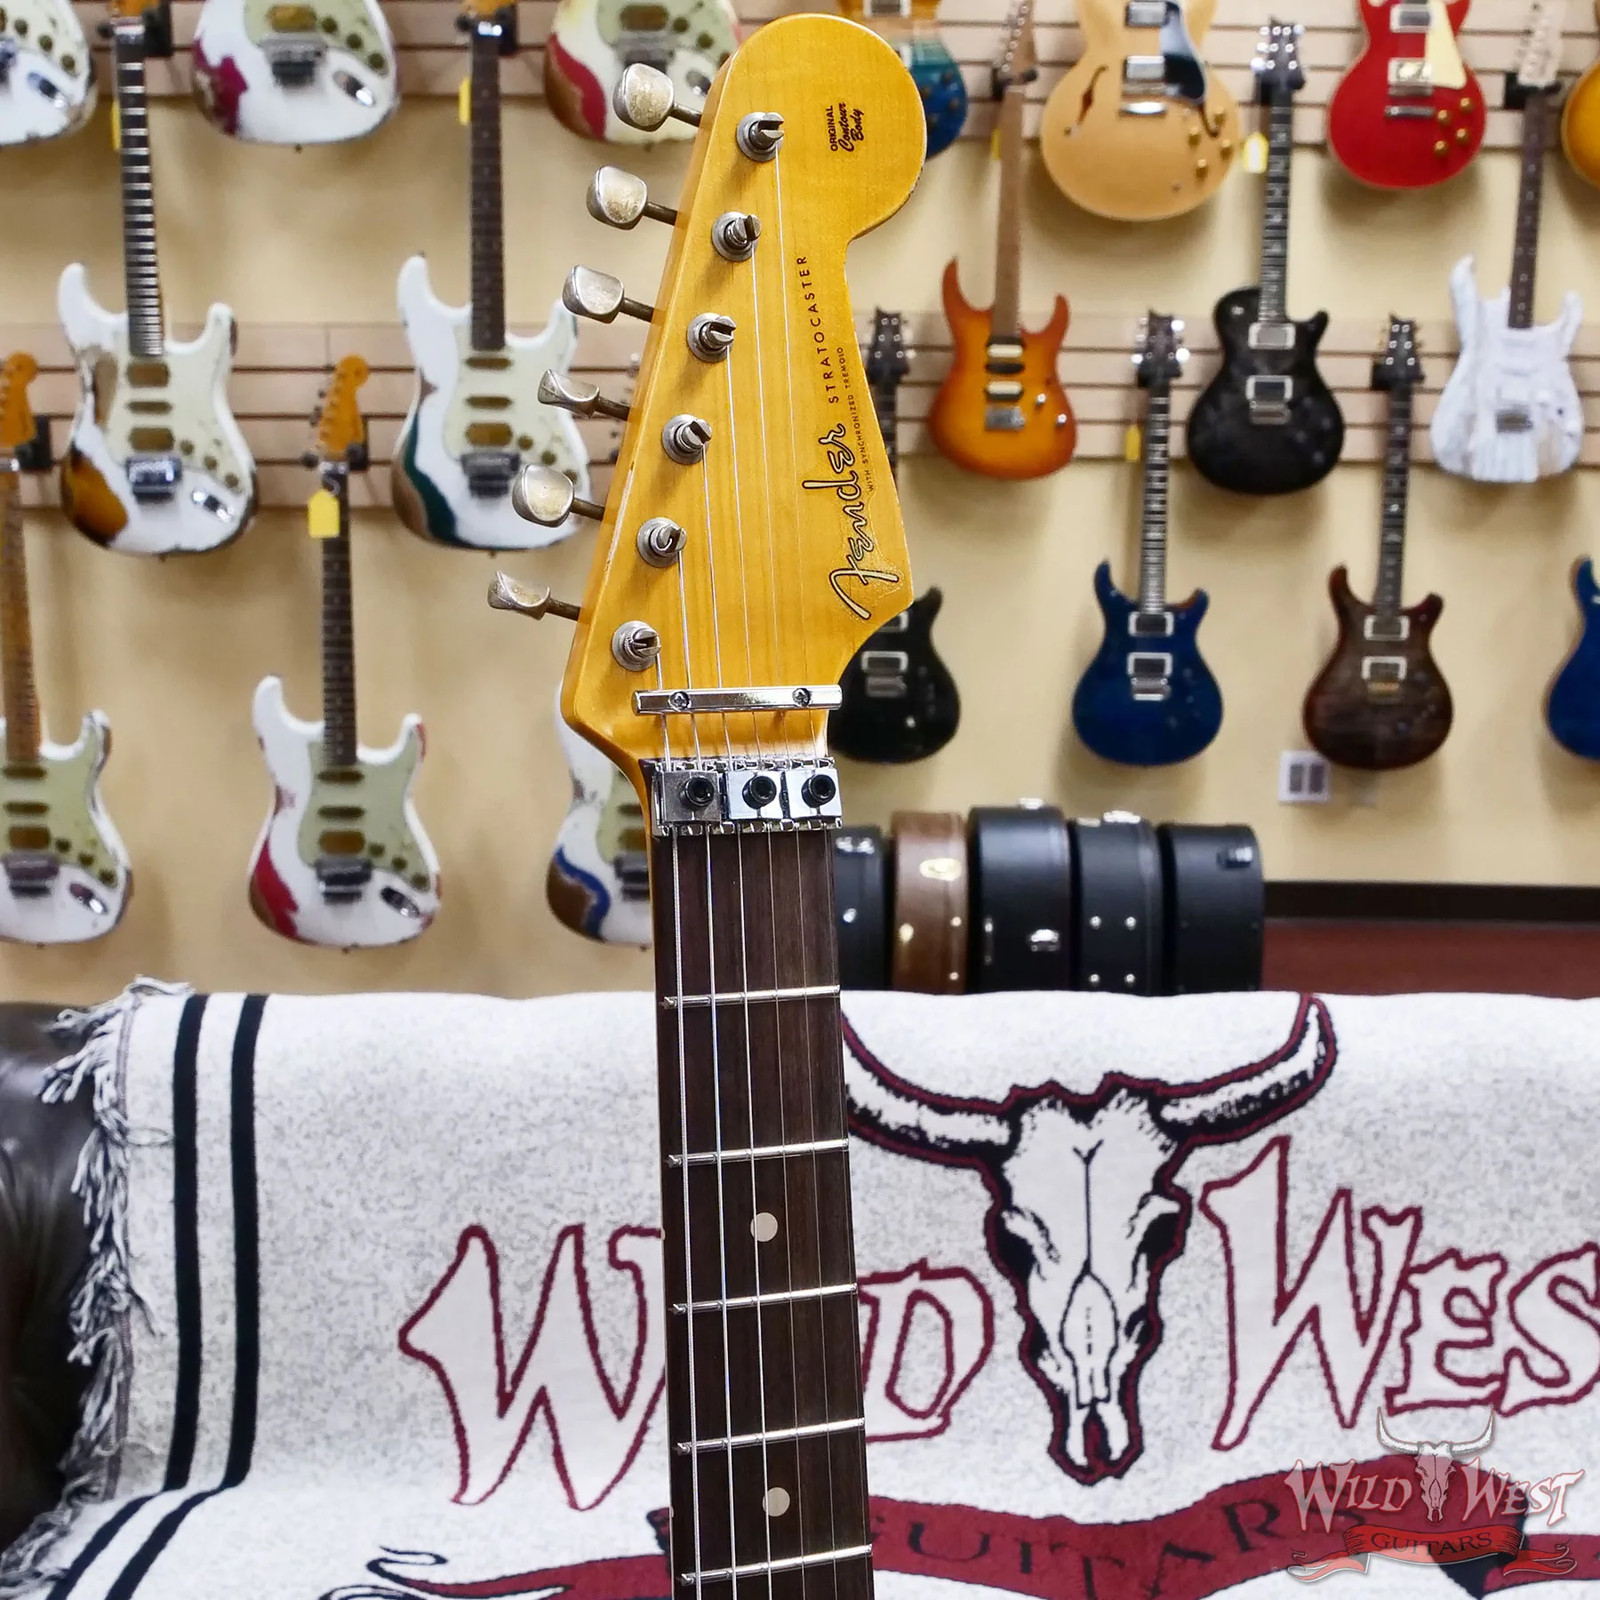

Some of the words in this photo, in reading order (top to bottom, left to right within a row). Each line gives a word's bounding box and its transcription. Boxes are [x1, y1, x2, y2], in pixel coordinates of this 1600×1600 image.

[825, 105, 839, 152] ORIGINAL
[838, 102, 855, 152] Contour
[850, 108, 865, 141] Body
[796, 256, 839, 404] STRATOCASTER
[847, 394, 869, 464] SYNCHRONIZED
[864, 470, 874, 492] WITH
[802, 423, 900, 619] Fender
[1199, 1135, 1600, 1452] WES
